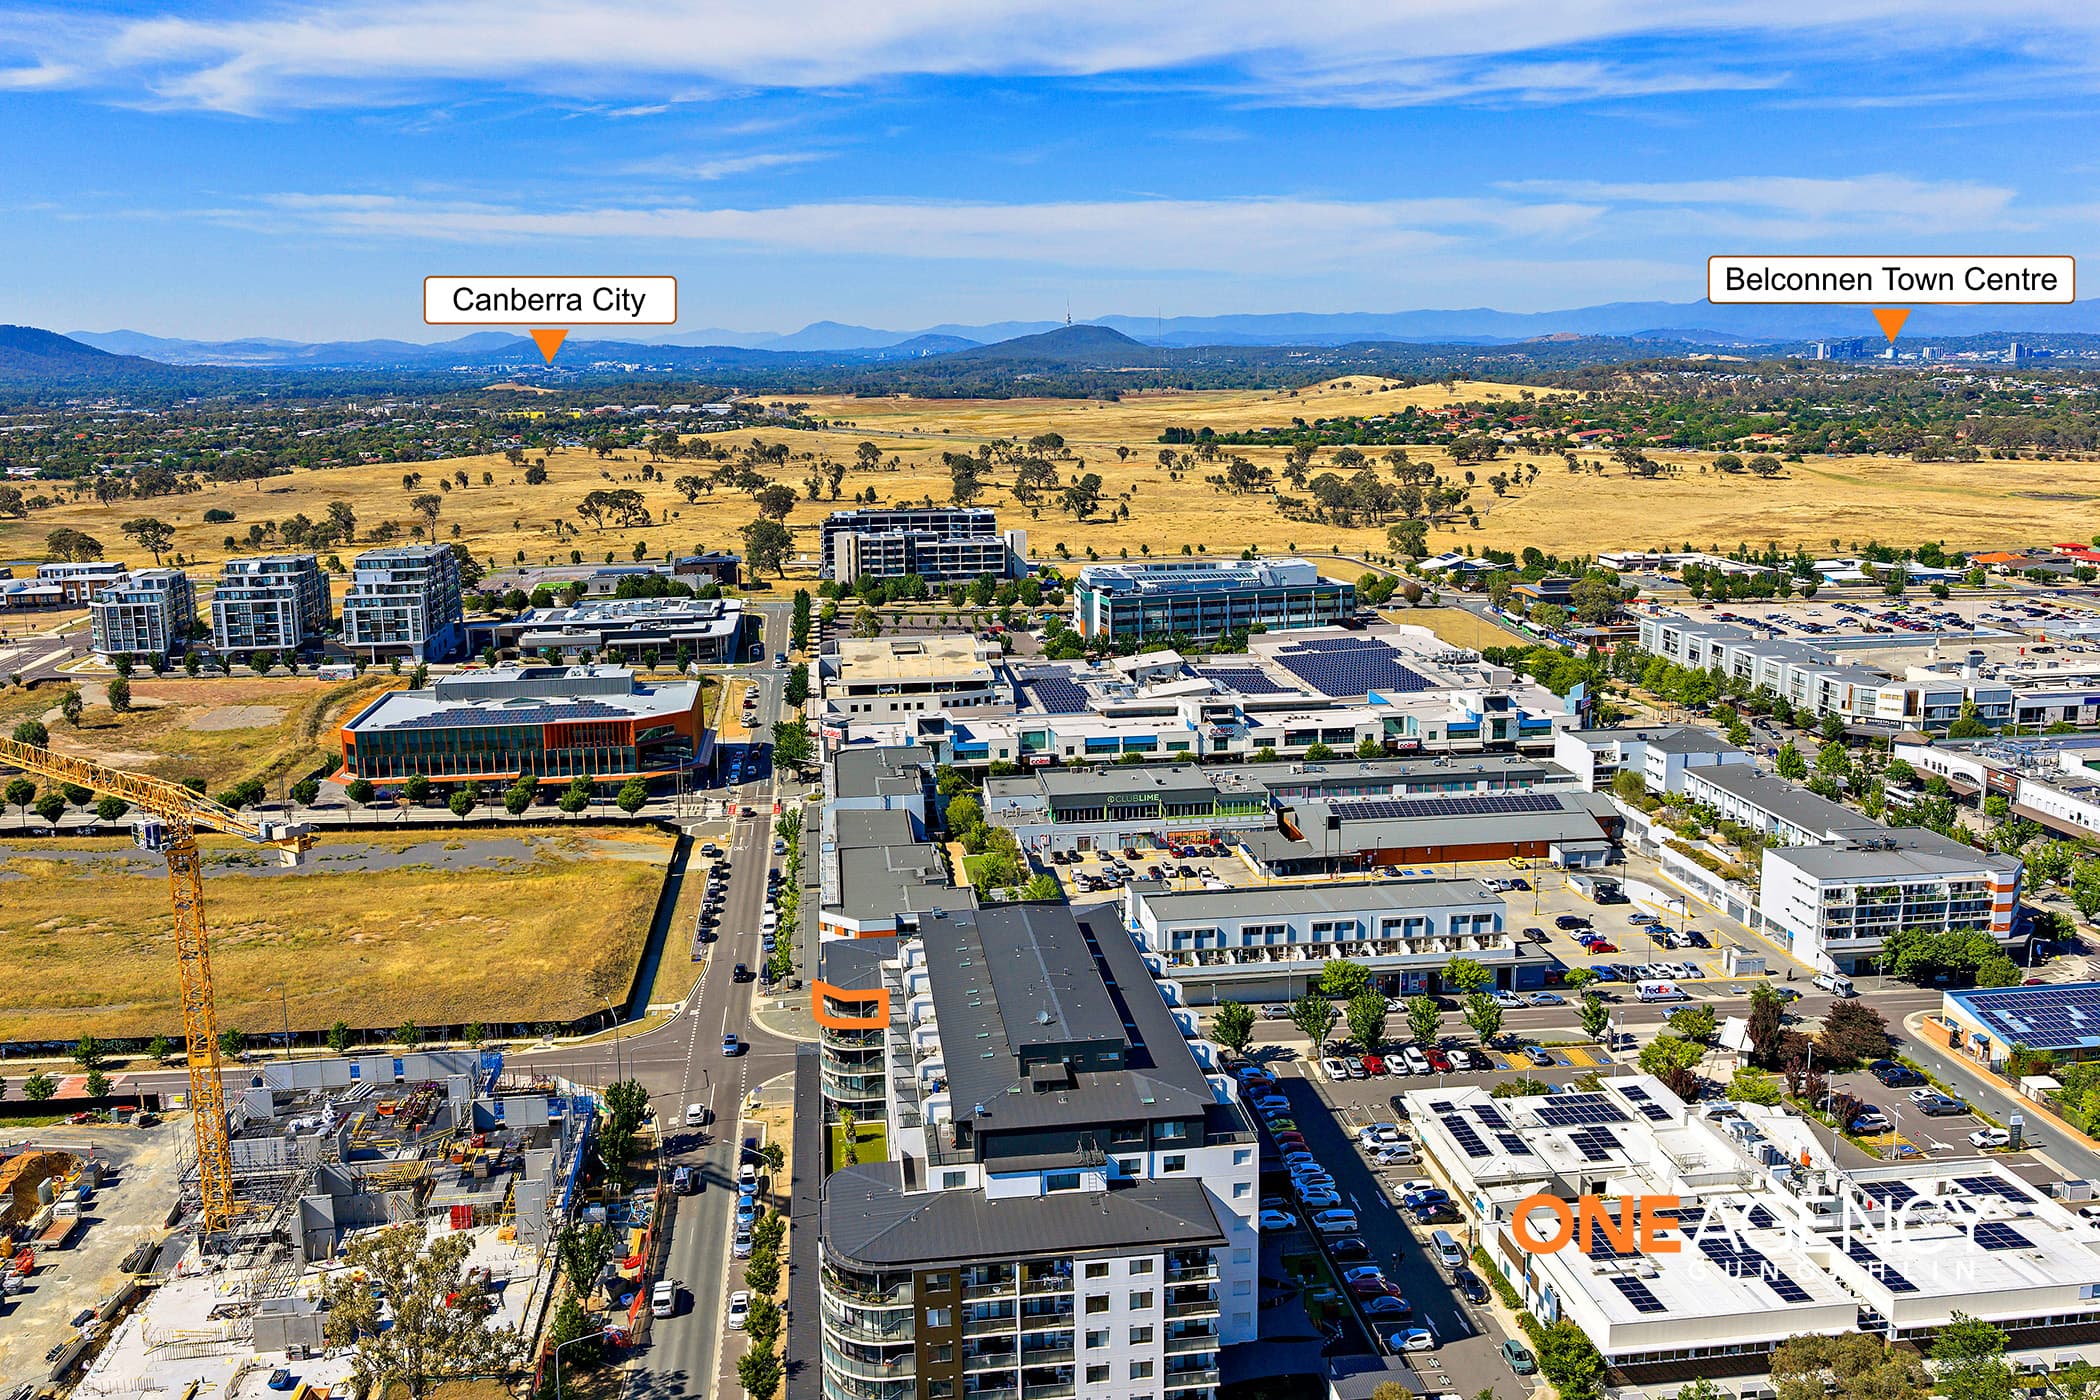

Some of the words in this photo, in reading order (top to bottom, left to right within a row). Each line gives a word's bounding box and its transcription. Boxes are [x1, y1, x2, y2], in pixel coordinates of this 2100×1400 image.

[823, 729, 842, 738] coles
[1210, 726, 1234, 735] coles
[1399, 741, 1417, 749] coles
[1031, 757, 1050, 765] coles
[1645, 985, 1670, 994] FedEx
